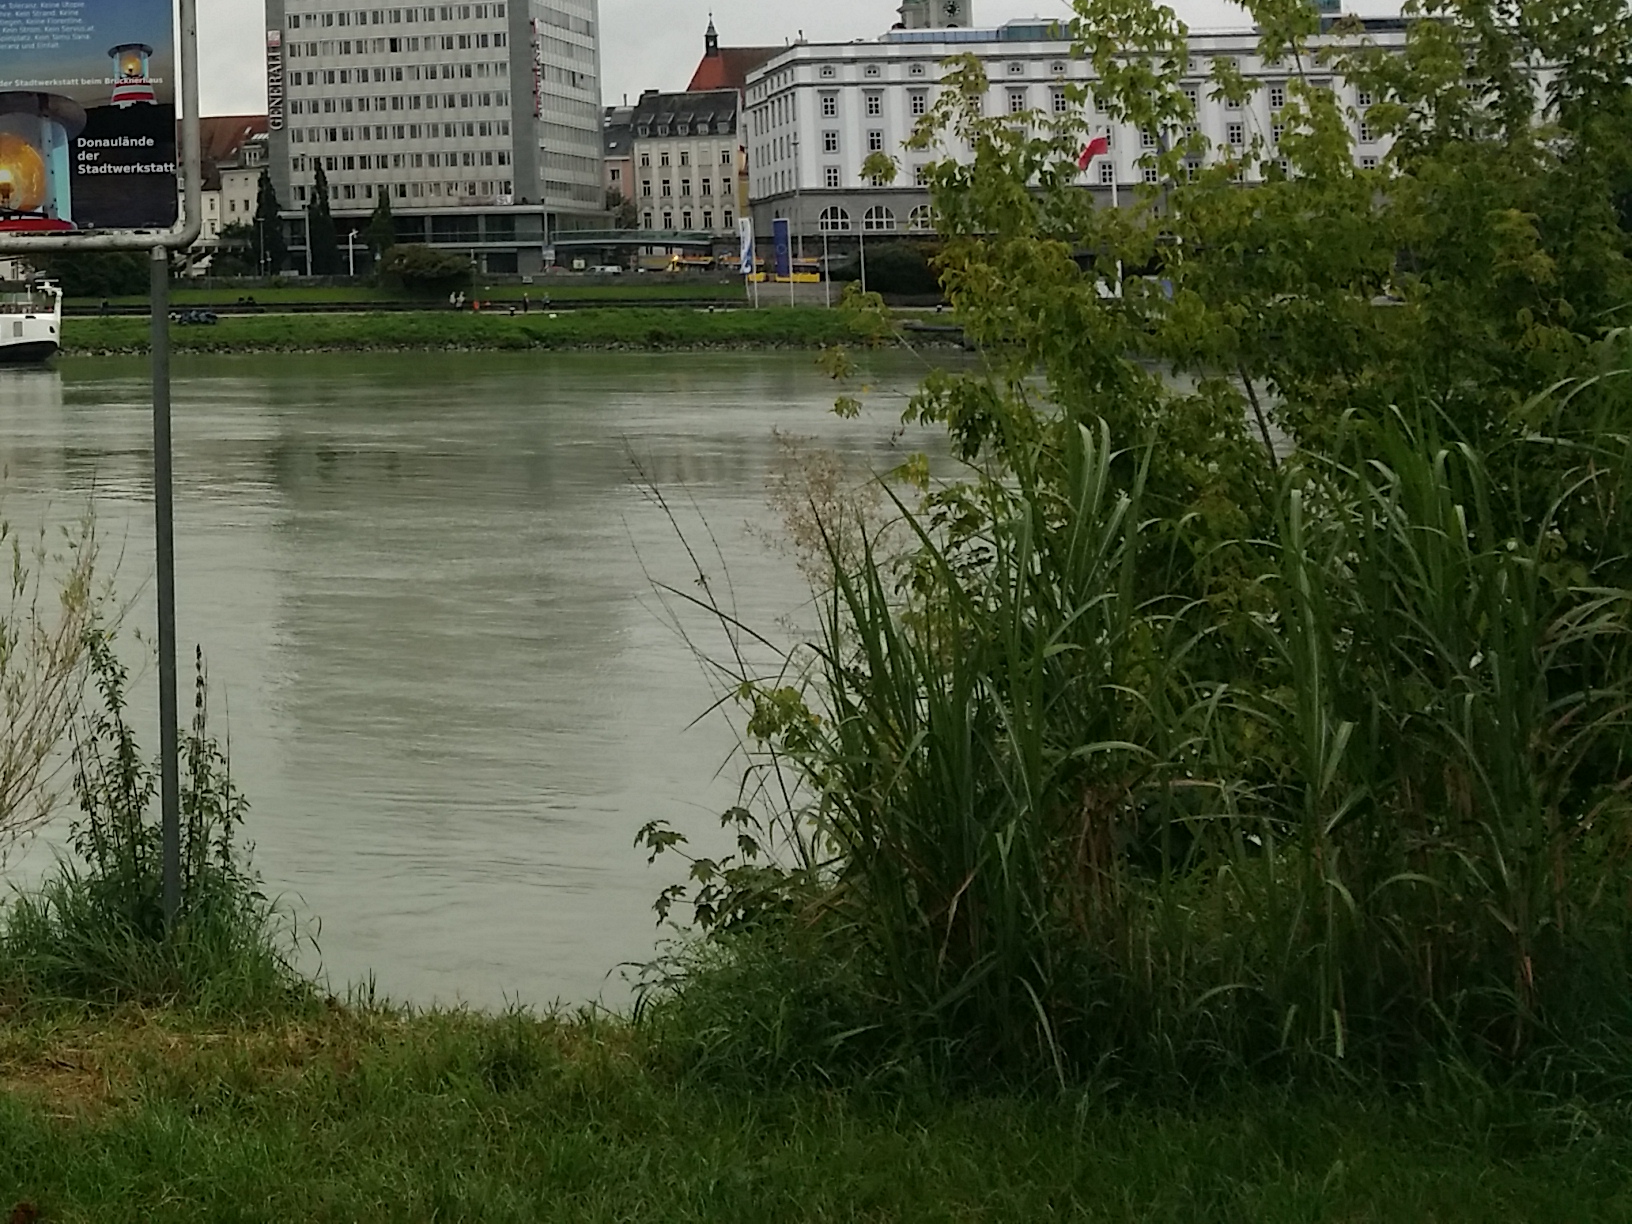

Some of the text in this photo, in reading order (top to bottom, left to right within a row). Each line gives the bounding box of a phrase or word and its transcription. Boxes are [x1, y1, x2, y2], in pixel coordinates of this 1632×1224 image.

[15, 78, 79, 86] Stadtwerkstatt
[81, 77, 102, 85] beim
[268, 52, 283, 130] GENERALI
[77, 136, 154, 147] Donaulände
[77, 150, 100, 161] der
[77, 162, 175, 174] Stadtwerkstatt
